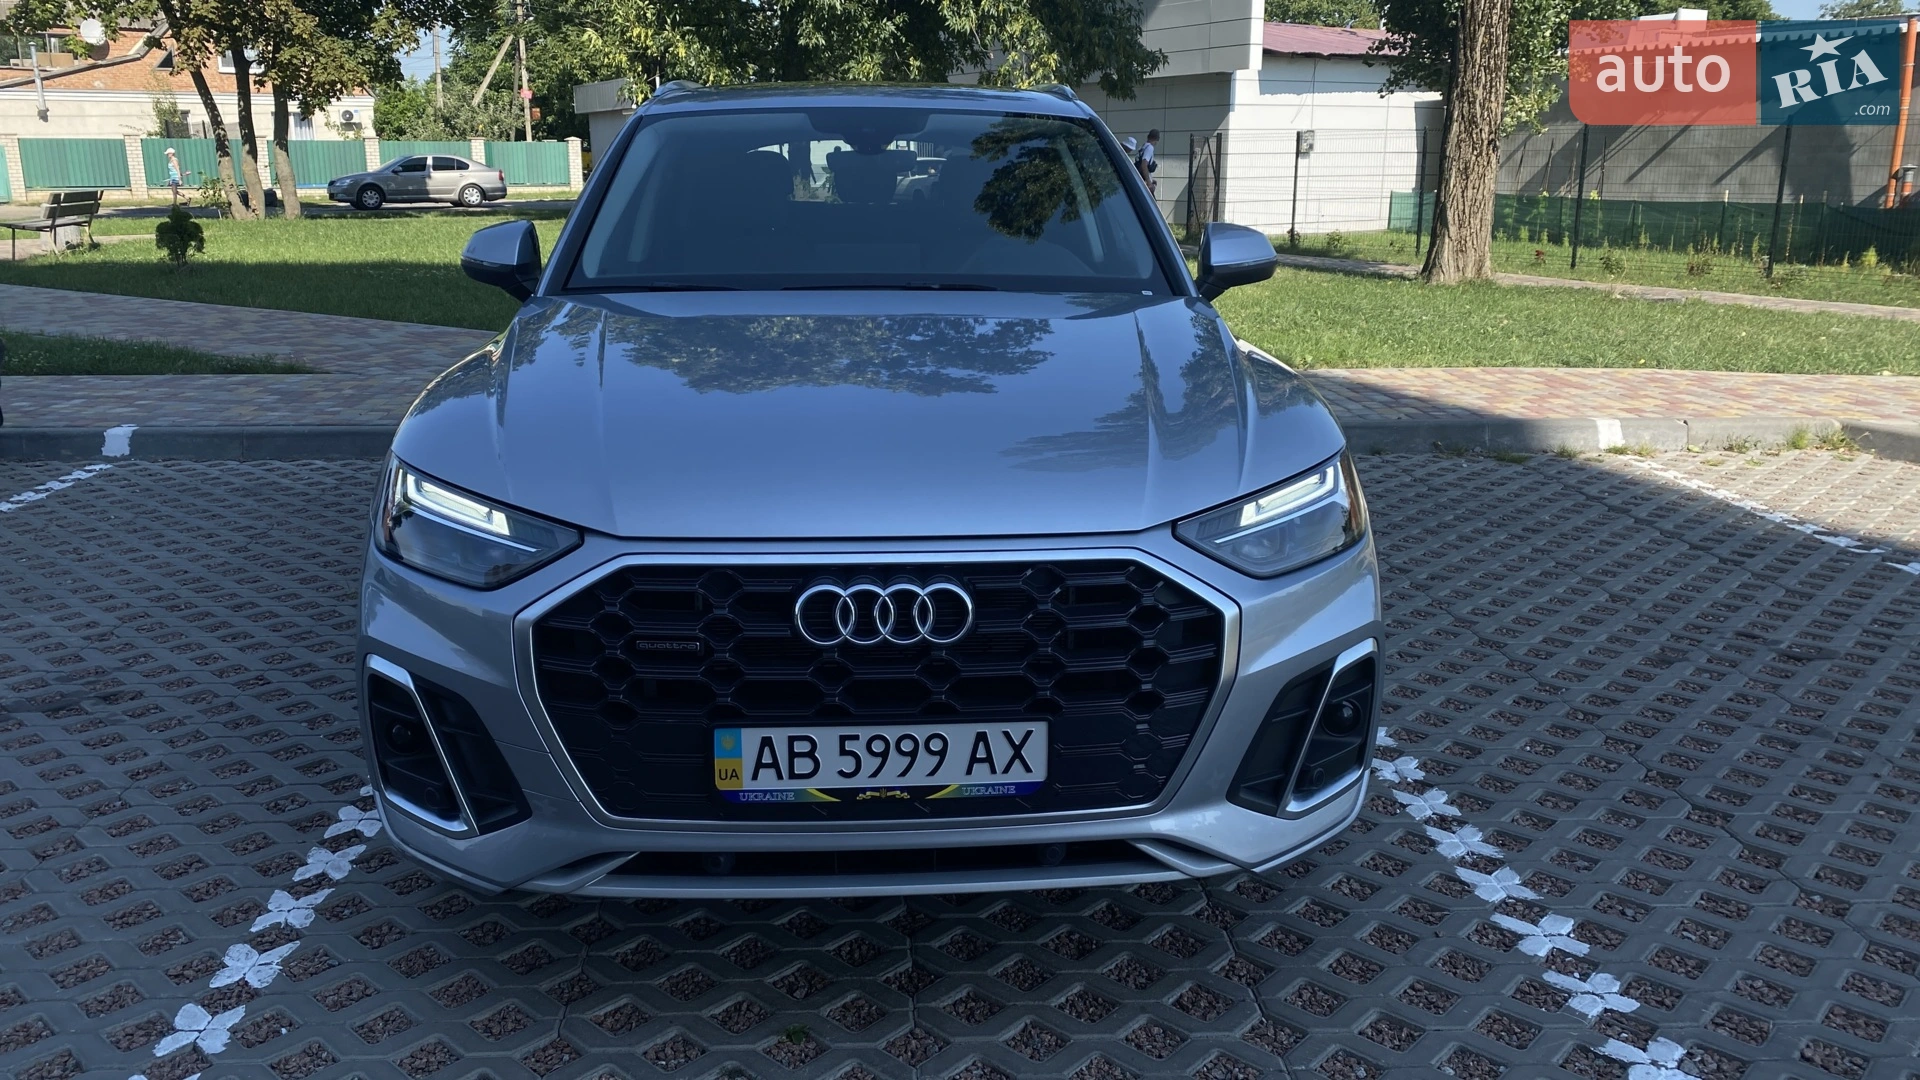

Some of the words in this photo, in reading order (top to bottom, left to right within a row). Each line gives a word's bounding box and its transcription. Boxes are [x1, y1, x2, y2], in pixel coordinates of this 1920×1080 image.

[751, 734, 821, 781] AB
[836, 731, 950, 778] 5999
[965, 729, 1035, 775] AX
[718, 767, 740, 781] UA
[961, 785, 1017, 796] UKRAINE
[739, 792, 796, 802] UKRAINE
